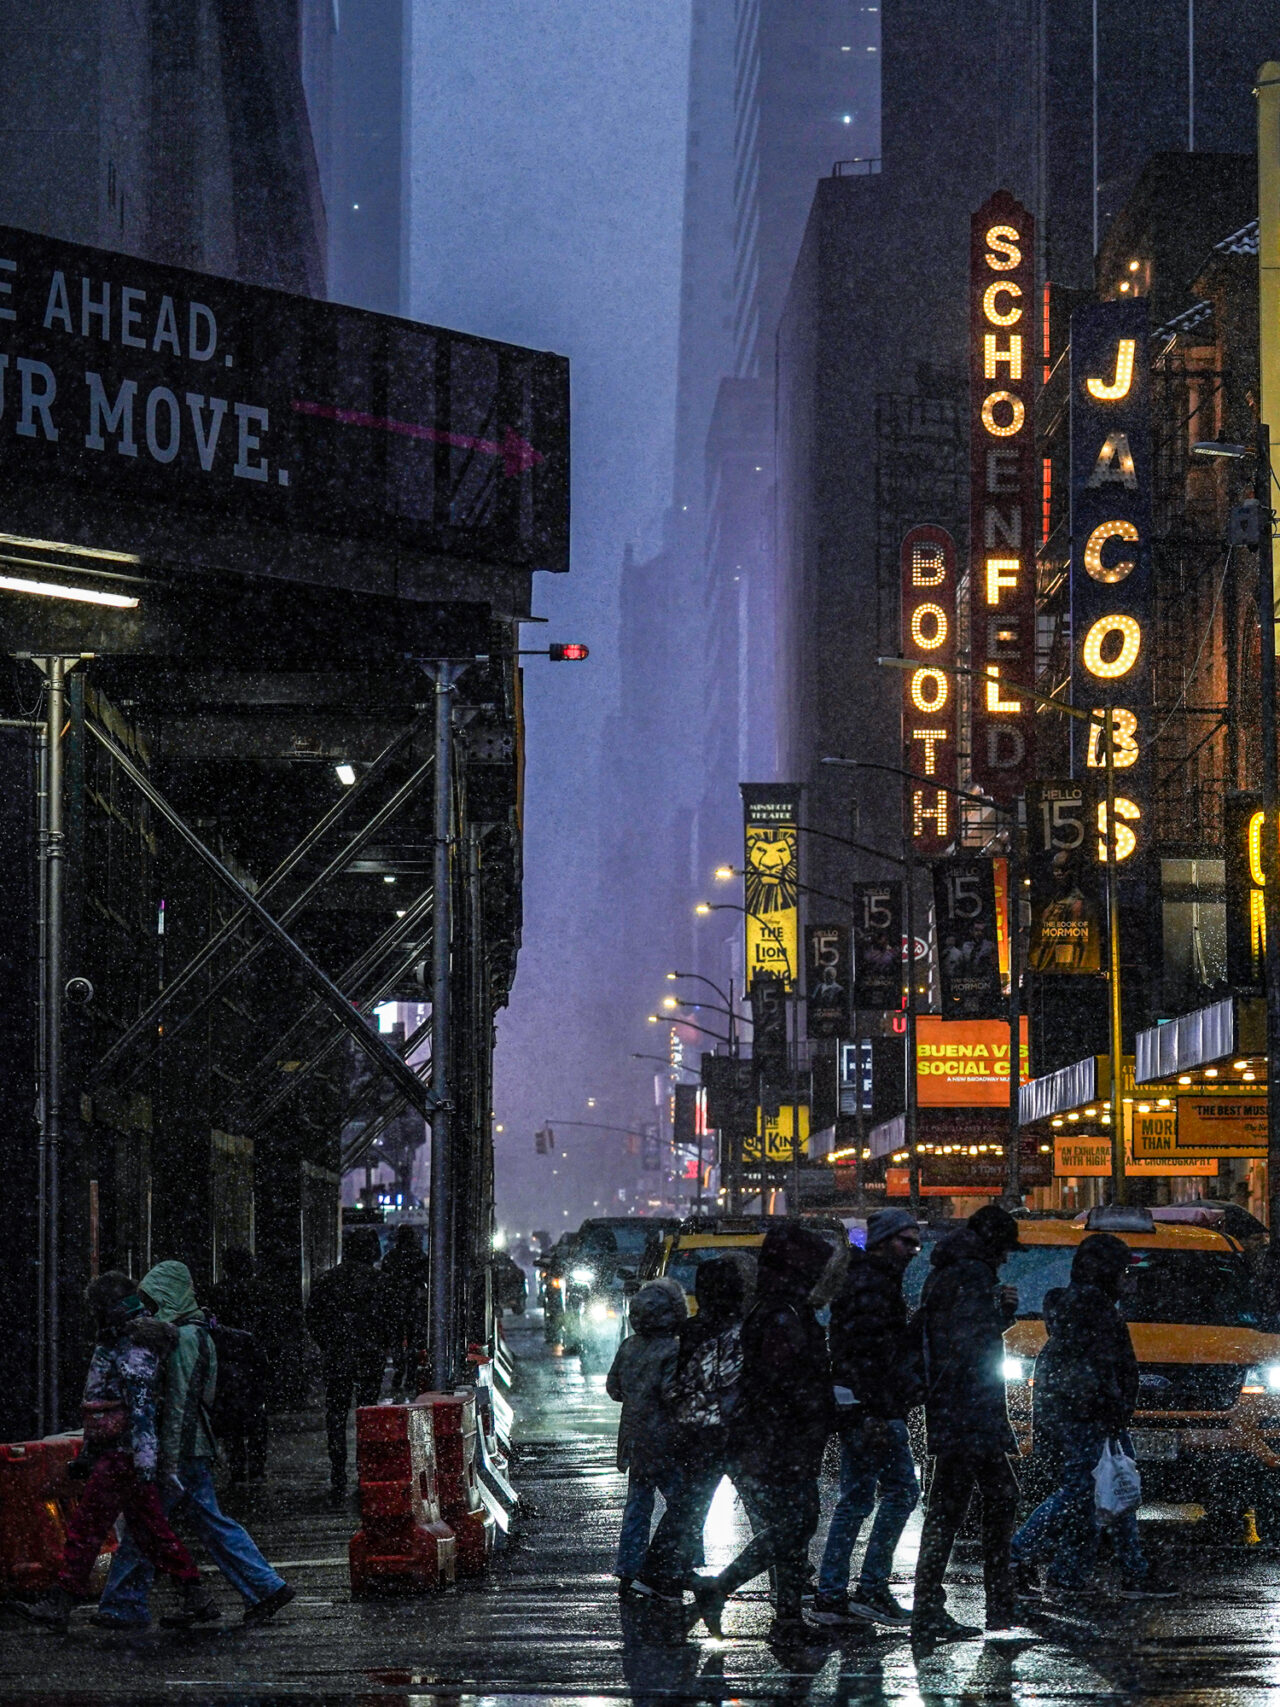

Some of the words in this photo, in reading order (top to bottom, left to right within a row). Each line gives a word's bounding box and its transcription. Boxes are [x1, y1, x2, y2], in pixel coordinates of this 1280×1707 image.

[42, 270, 233, 367] AHEAD.
[85, 371, 290, 486] MOVE.
[980, 225, 1026, 770] SCHOENFELD
[1083, 339, 1142, 862] JACOBS
[912, 541, 948, 836] BOOTH
[1042, 789, 1083, 800] HELLO
[1038, 800, 1085, 850] 15
[862, 896, 892, 928] 15
[944, 876, 983, 919] 15
[760, 928, 783, 938] THE
[1041, 928, 1089, 937] MORMON
[812, 937, 840, 967] 15
[917, 1044, 989, 1058] BUENA
[917, 1061, 990, 1076] SOCIAL
[1217, 1105, 1241, 1116] BEST
[1141, 1136, 1171, 1150] THAN
[1062, 1156, 1083, 1166] WITH
